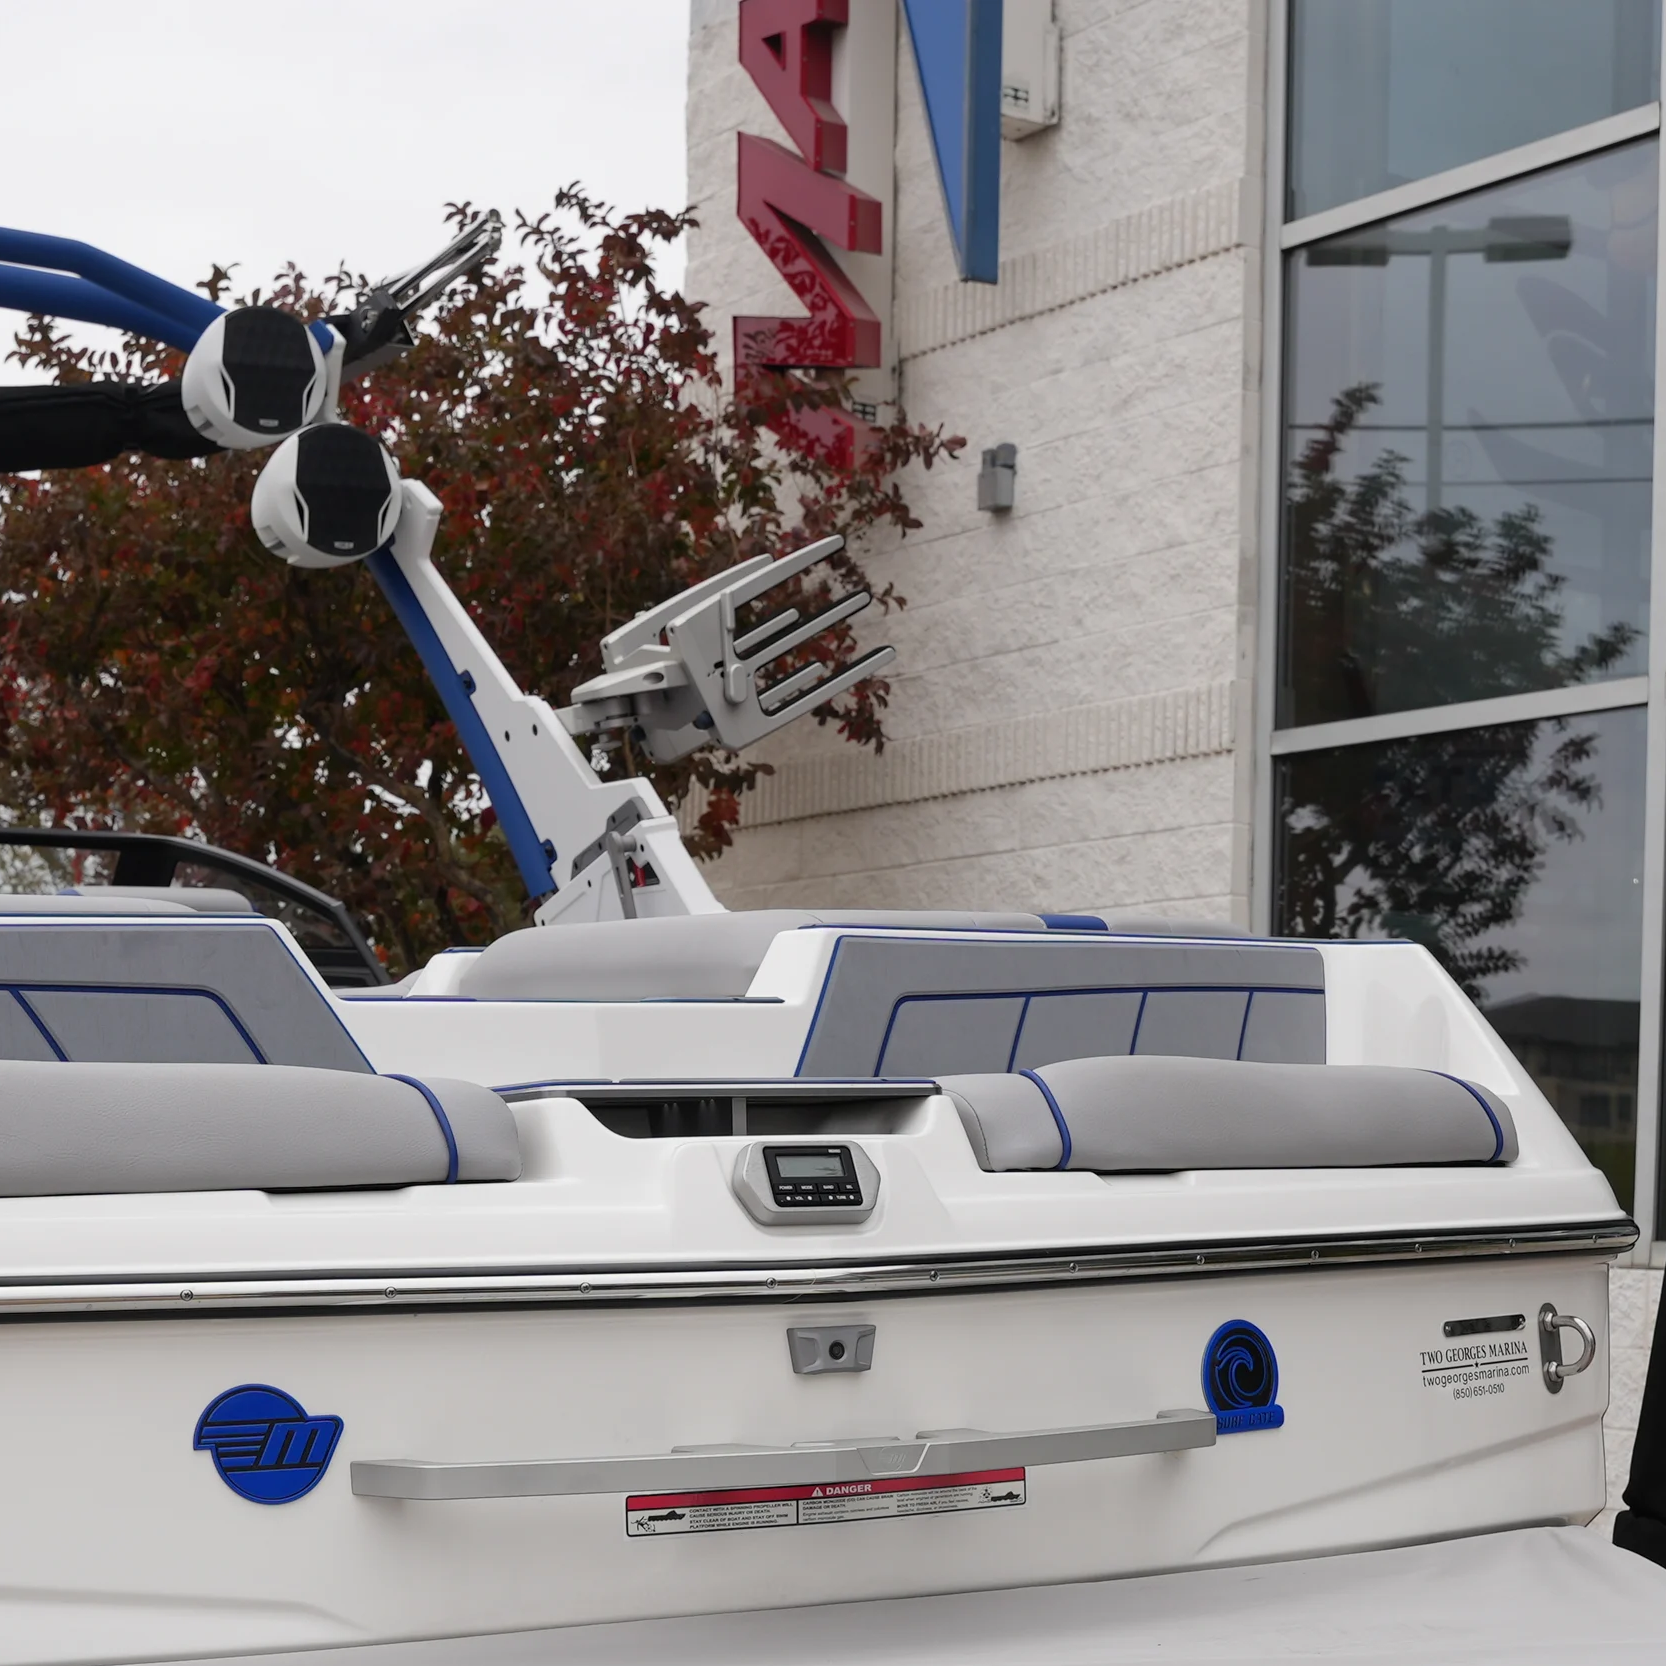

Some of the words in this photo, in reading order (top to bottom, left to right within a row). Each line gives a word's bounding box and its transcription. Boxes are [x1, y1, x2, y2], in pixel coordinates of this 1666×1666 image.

[1420, 1350, 1443, 1365] TWO
[1445, 1345, 1487, 1363] GEORGES
[1489, 1341, 1527, 1357] MARINA
[1423, 1364, 1530, 1388] twogeorgesmarina.com
[1453, 1386, 1473, 1400] (850)
[1473, 1383, 1505, 1396] 651-0510
[826, 1484, 871, 1494] DANGER
